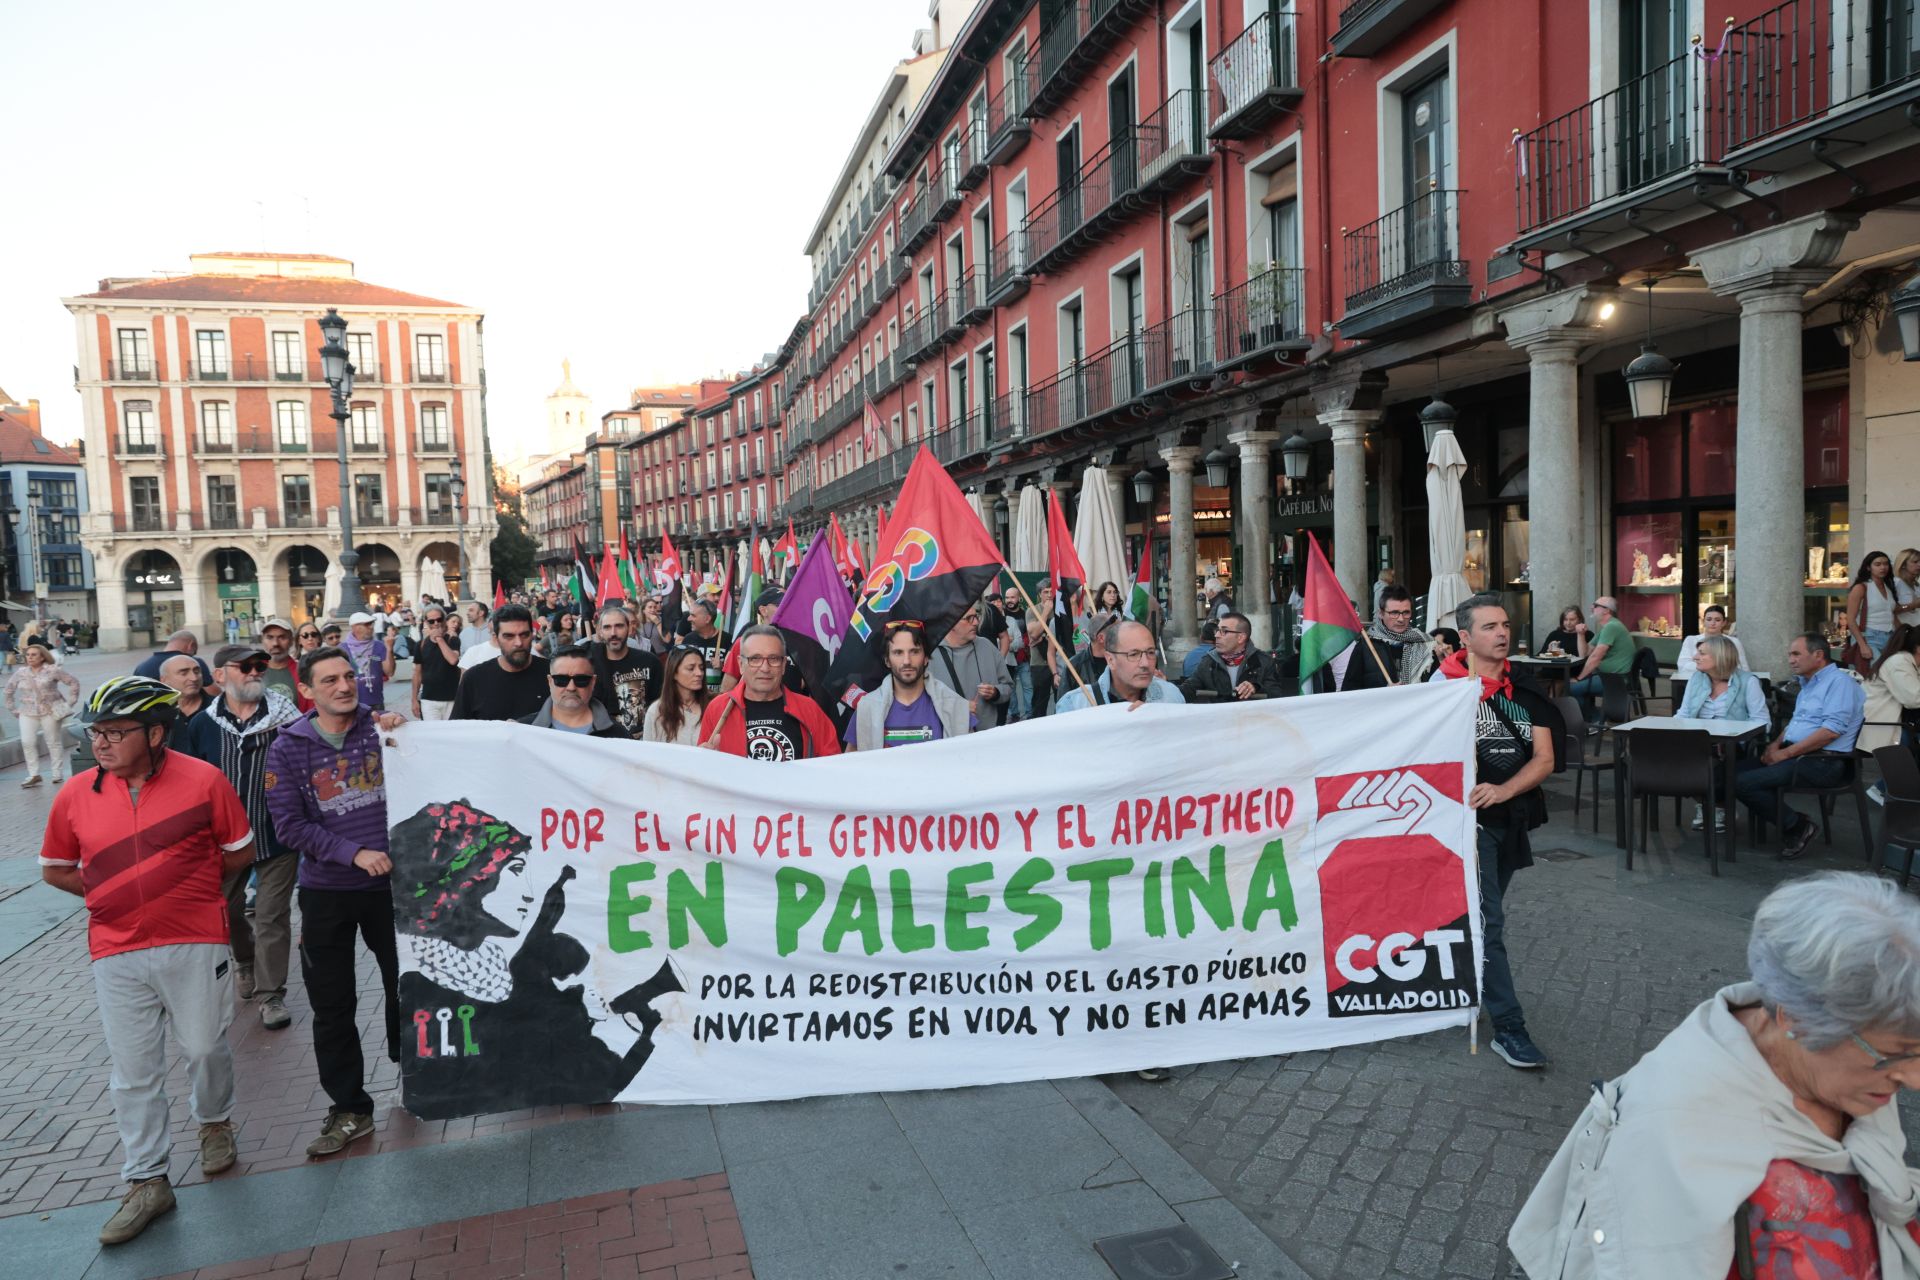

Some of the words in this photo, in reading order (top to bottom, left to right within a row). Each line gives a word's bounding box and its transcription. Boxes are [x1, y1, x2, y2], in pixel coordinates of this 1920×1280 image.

[1278, 497, 1300, 517] CAFÉ
[1301, 499, 1318, 514] DEL
[1320, 494, 1334, 513] NO
[746, 728, 789, 747] BACEX
[541, 807, 605, 852] POR
[635, 811, 671, 852] EL
[685, 813, 737, 855] FIN
[753, 812, 812, 858] DEL
[829, 812, 999, 858] GENOCIDIO
[1015, 807, 1039, 852] Y
[1057, 804, 1096, 849] EL
[1110, 787, 1295, 846] APARTHEID
[607, 861, 729, 954] EN
[775, 838, 1300, 957] PALESTINA
[701, 974, 755, 1000] POR
[765, 973, 796, 999] LA
[809, 962, 1033, 999] REDISTRIBUCIÓN
[1046, 969, 1095, 993] DEL
[1106, 964, 1199, 992] GASTO
[1207, 949, 1307, 983] PÚBLICO
[1335, 929, 1466, 984] CGT
[693, 1007, 894, 1043] INVIRTAMOS
[909, 1006, 950, 1039] EN
[964, 1005, 1037, 1035] VIDA
[1049, 1005, 1070, 1037] Y
[1087, 1003, 1129, 1033] NO
[1145, 998, 1187, 1029] EN
[1198, 986, 1311, 1021] ARMAS
[1334, 989, 1471, 1013] VALLADOLID
